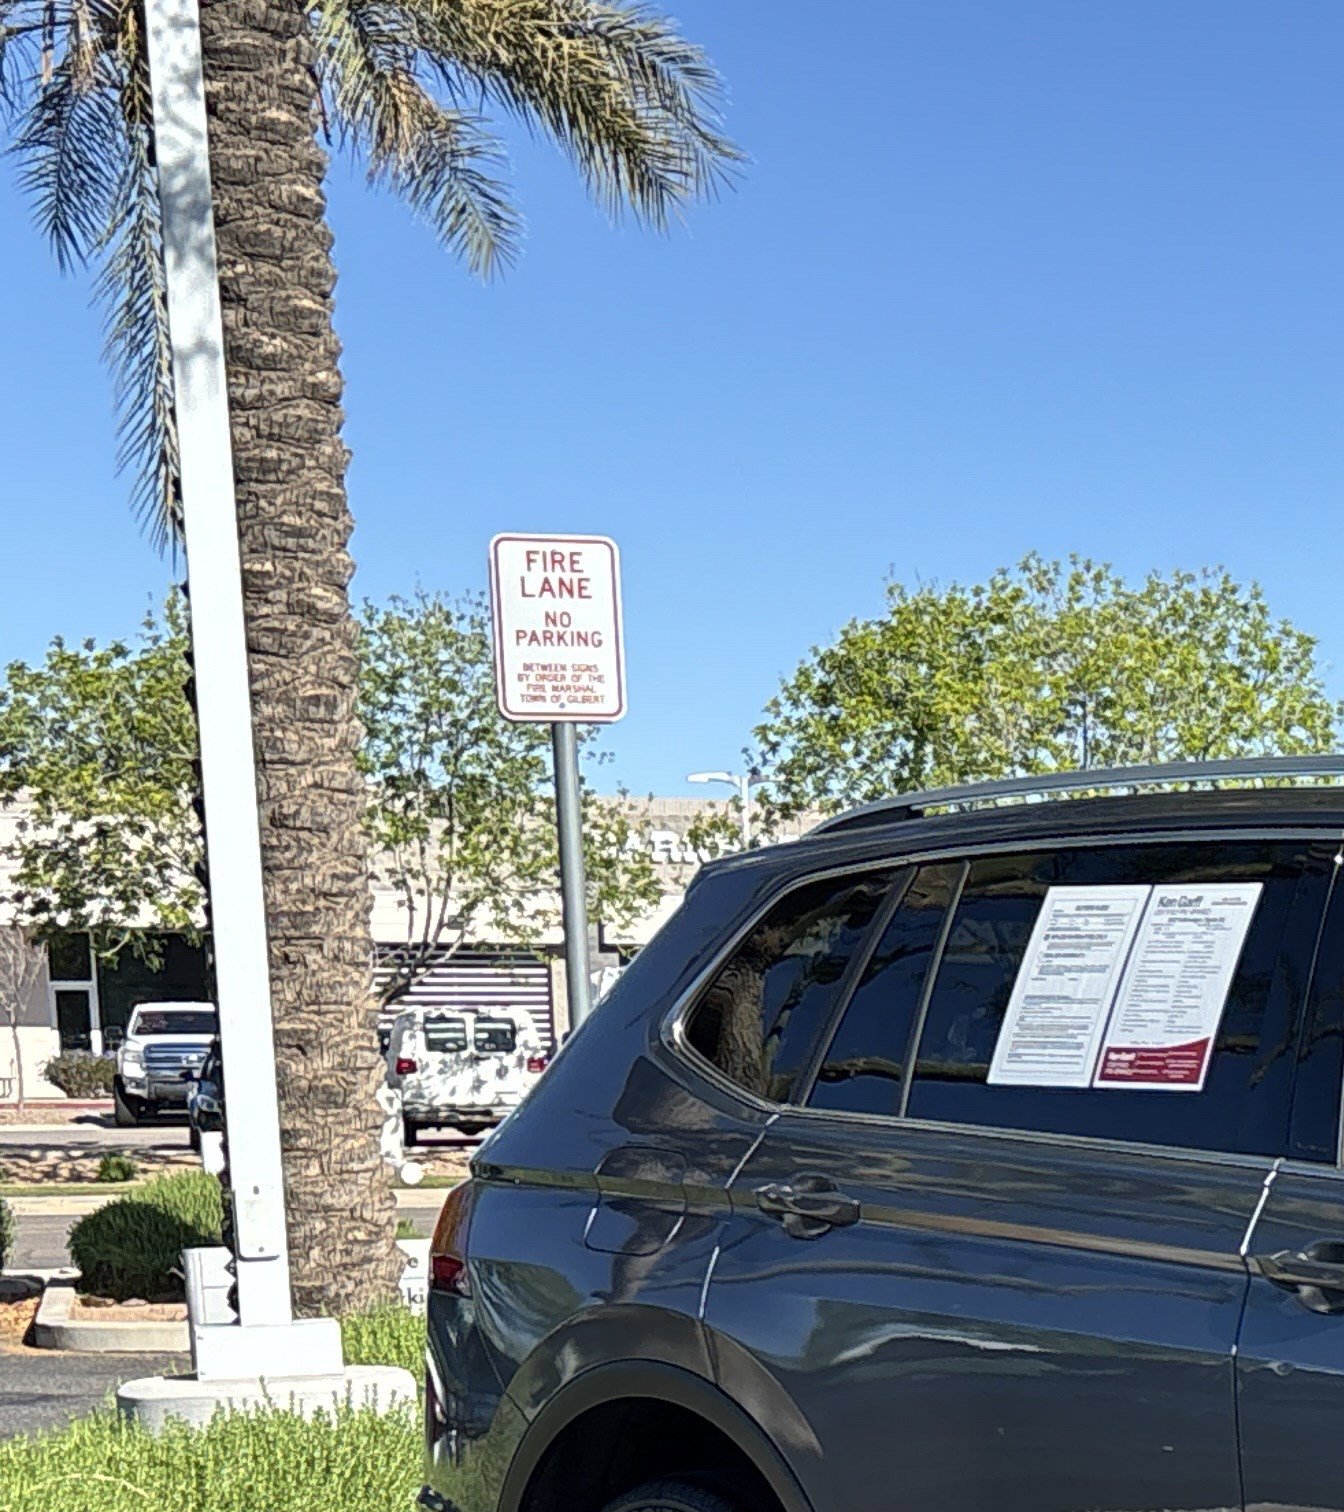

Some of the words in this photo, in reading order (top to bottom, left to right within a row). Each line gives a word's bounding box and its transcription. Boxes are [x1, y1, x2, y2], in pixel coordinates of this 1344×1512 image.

[525, 550, 584, 573] FIRE
[520, 576, 592, 599] LANE
[544, 611, 572, 628] NO
[515, 630, 603, 648] PARKING
[522, 662, 567, 672] BETWEEN
[571, 664, 599, 673] SIGNS
[517, 673, 531, 683] BY
[535, 673, 567, 683] ORDER
[570, 674, 583, 683] OF
[588, 674, 605, 684] THE
[551, 684, 597, 694] MARSHAL
[520, 693, 547, 703] TOWN
[550, 694, 562, 704] OF
[567, 694, 605, 704] GILBERT
